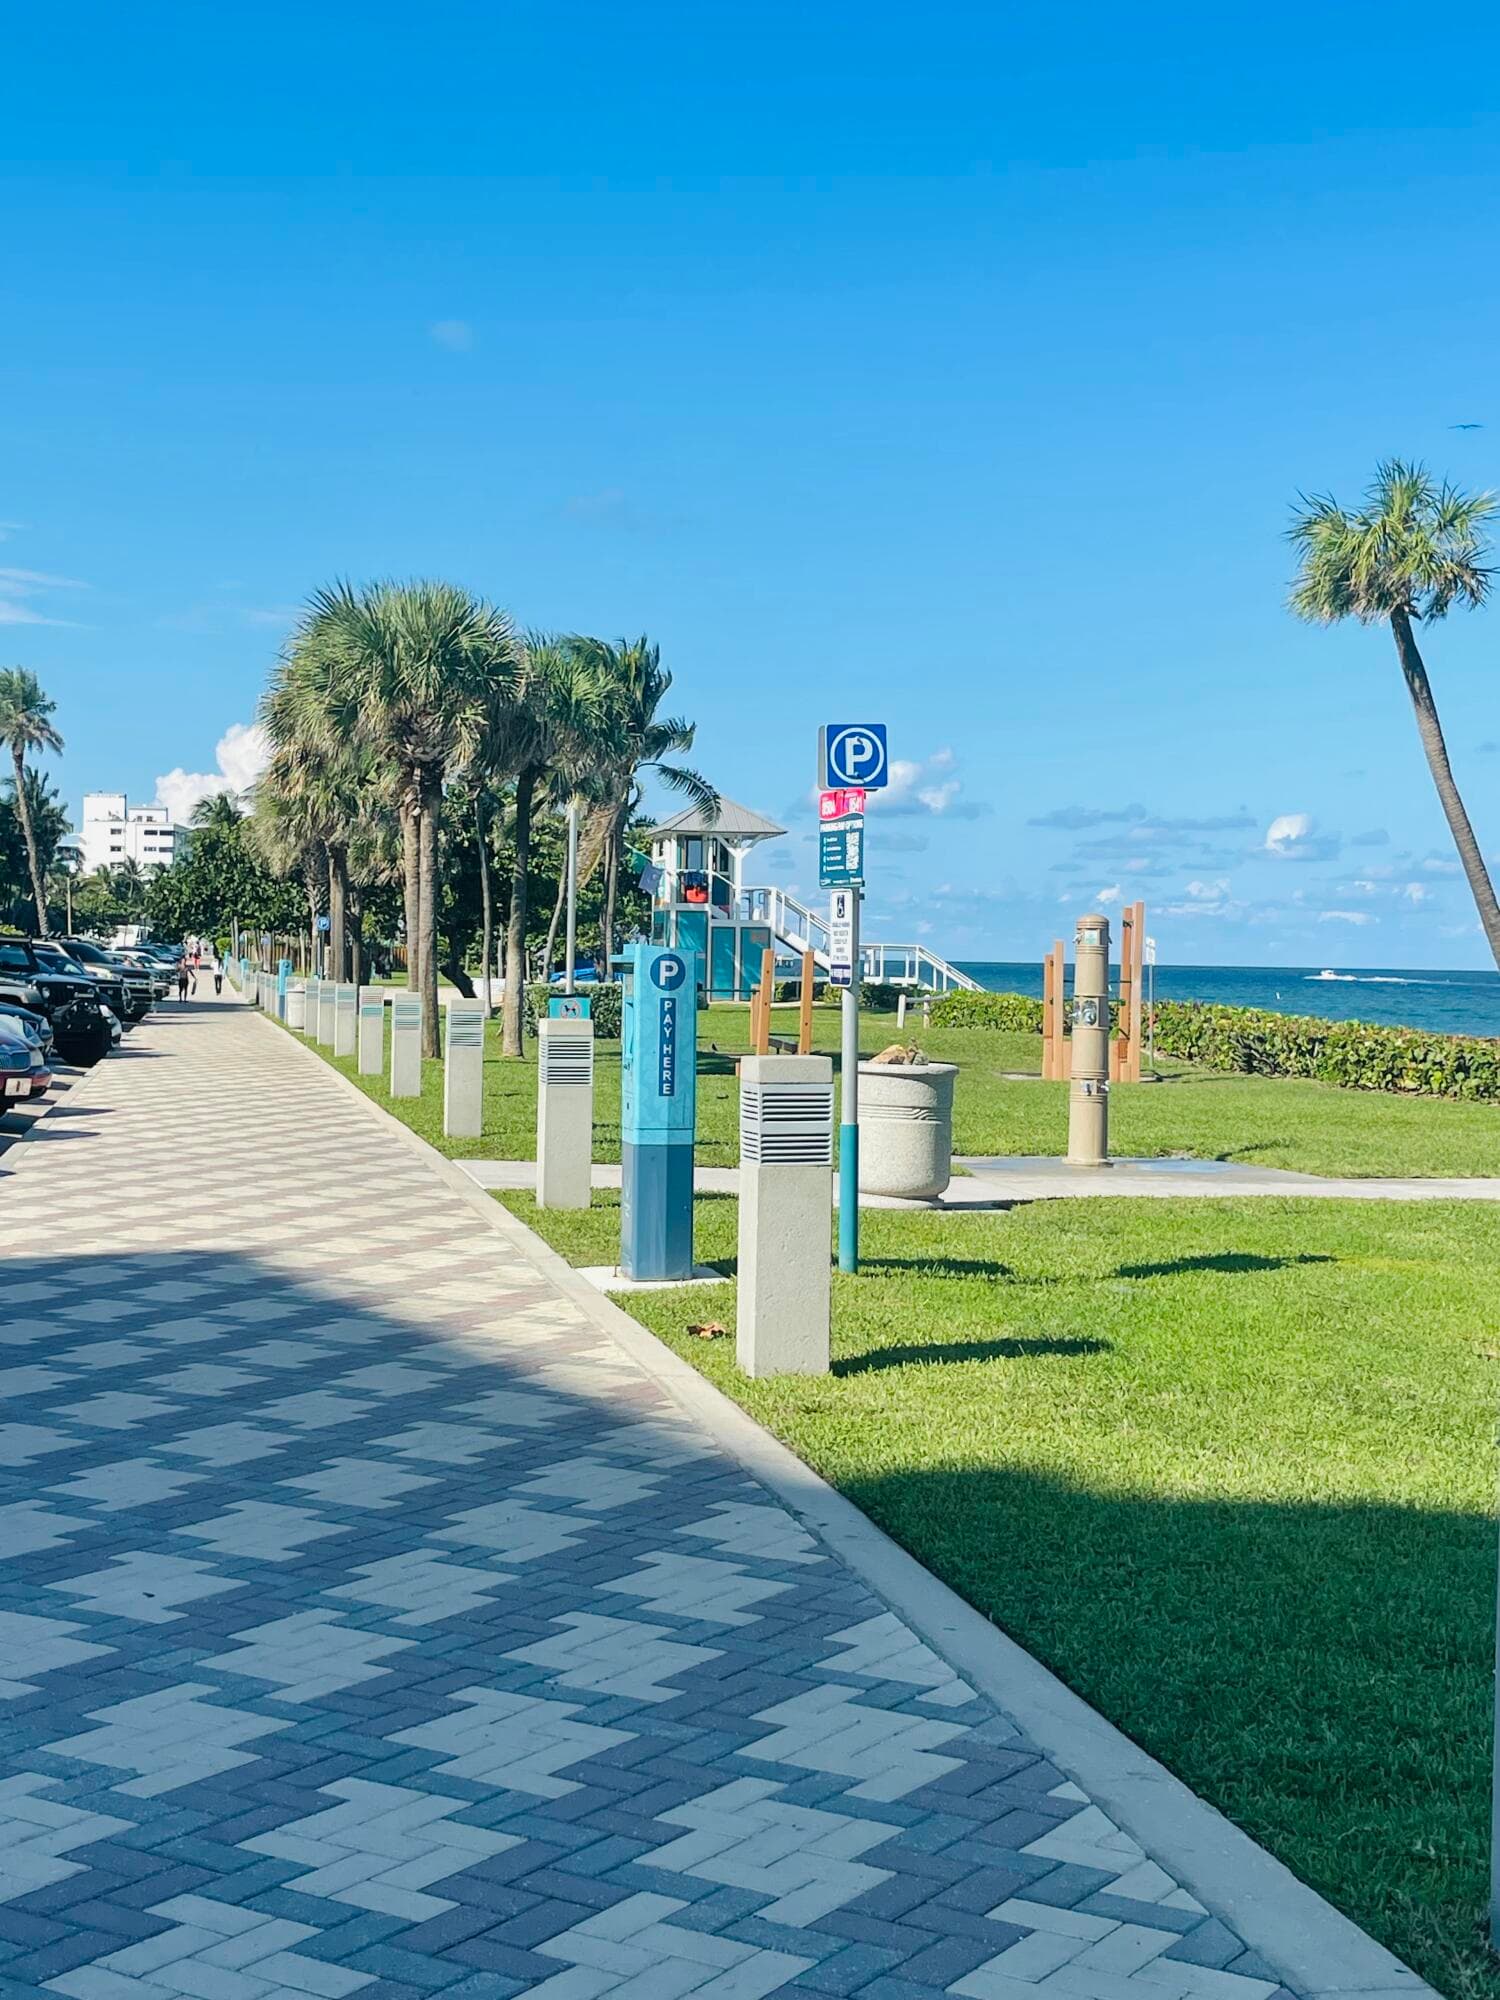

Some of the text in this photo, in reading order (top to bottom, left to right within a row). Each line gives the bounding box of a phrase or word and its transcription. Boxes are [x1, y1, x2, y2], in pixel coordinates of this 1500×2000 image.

[845, 736, 873, 776] P
[659, 960, 679, 986] P
[662, 1000, 673, 1095] PAY HERE
